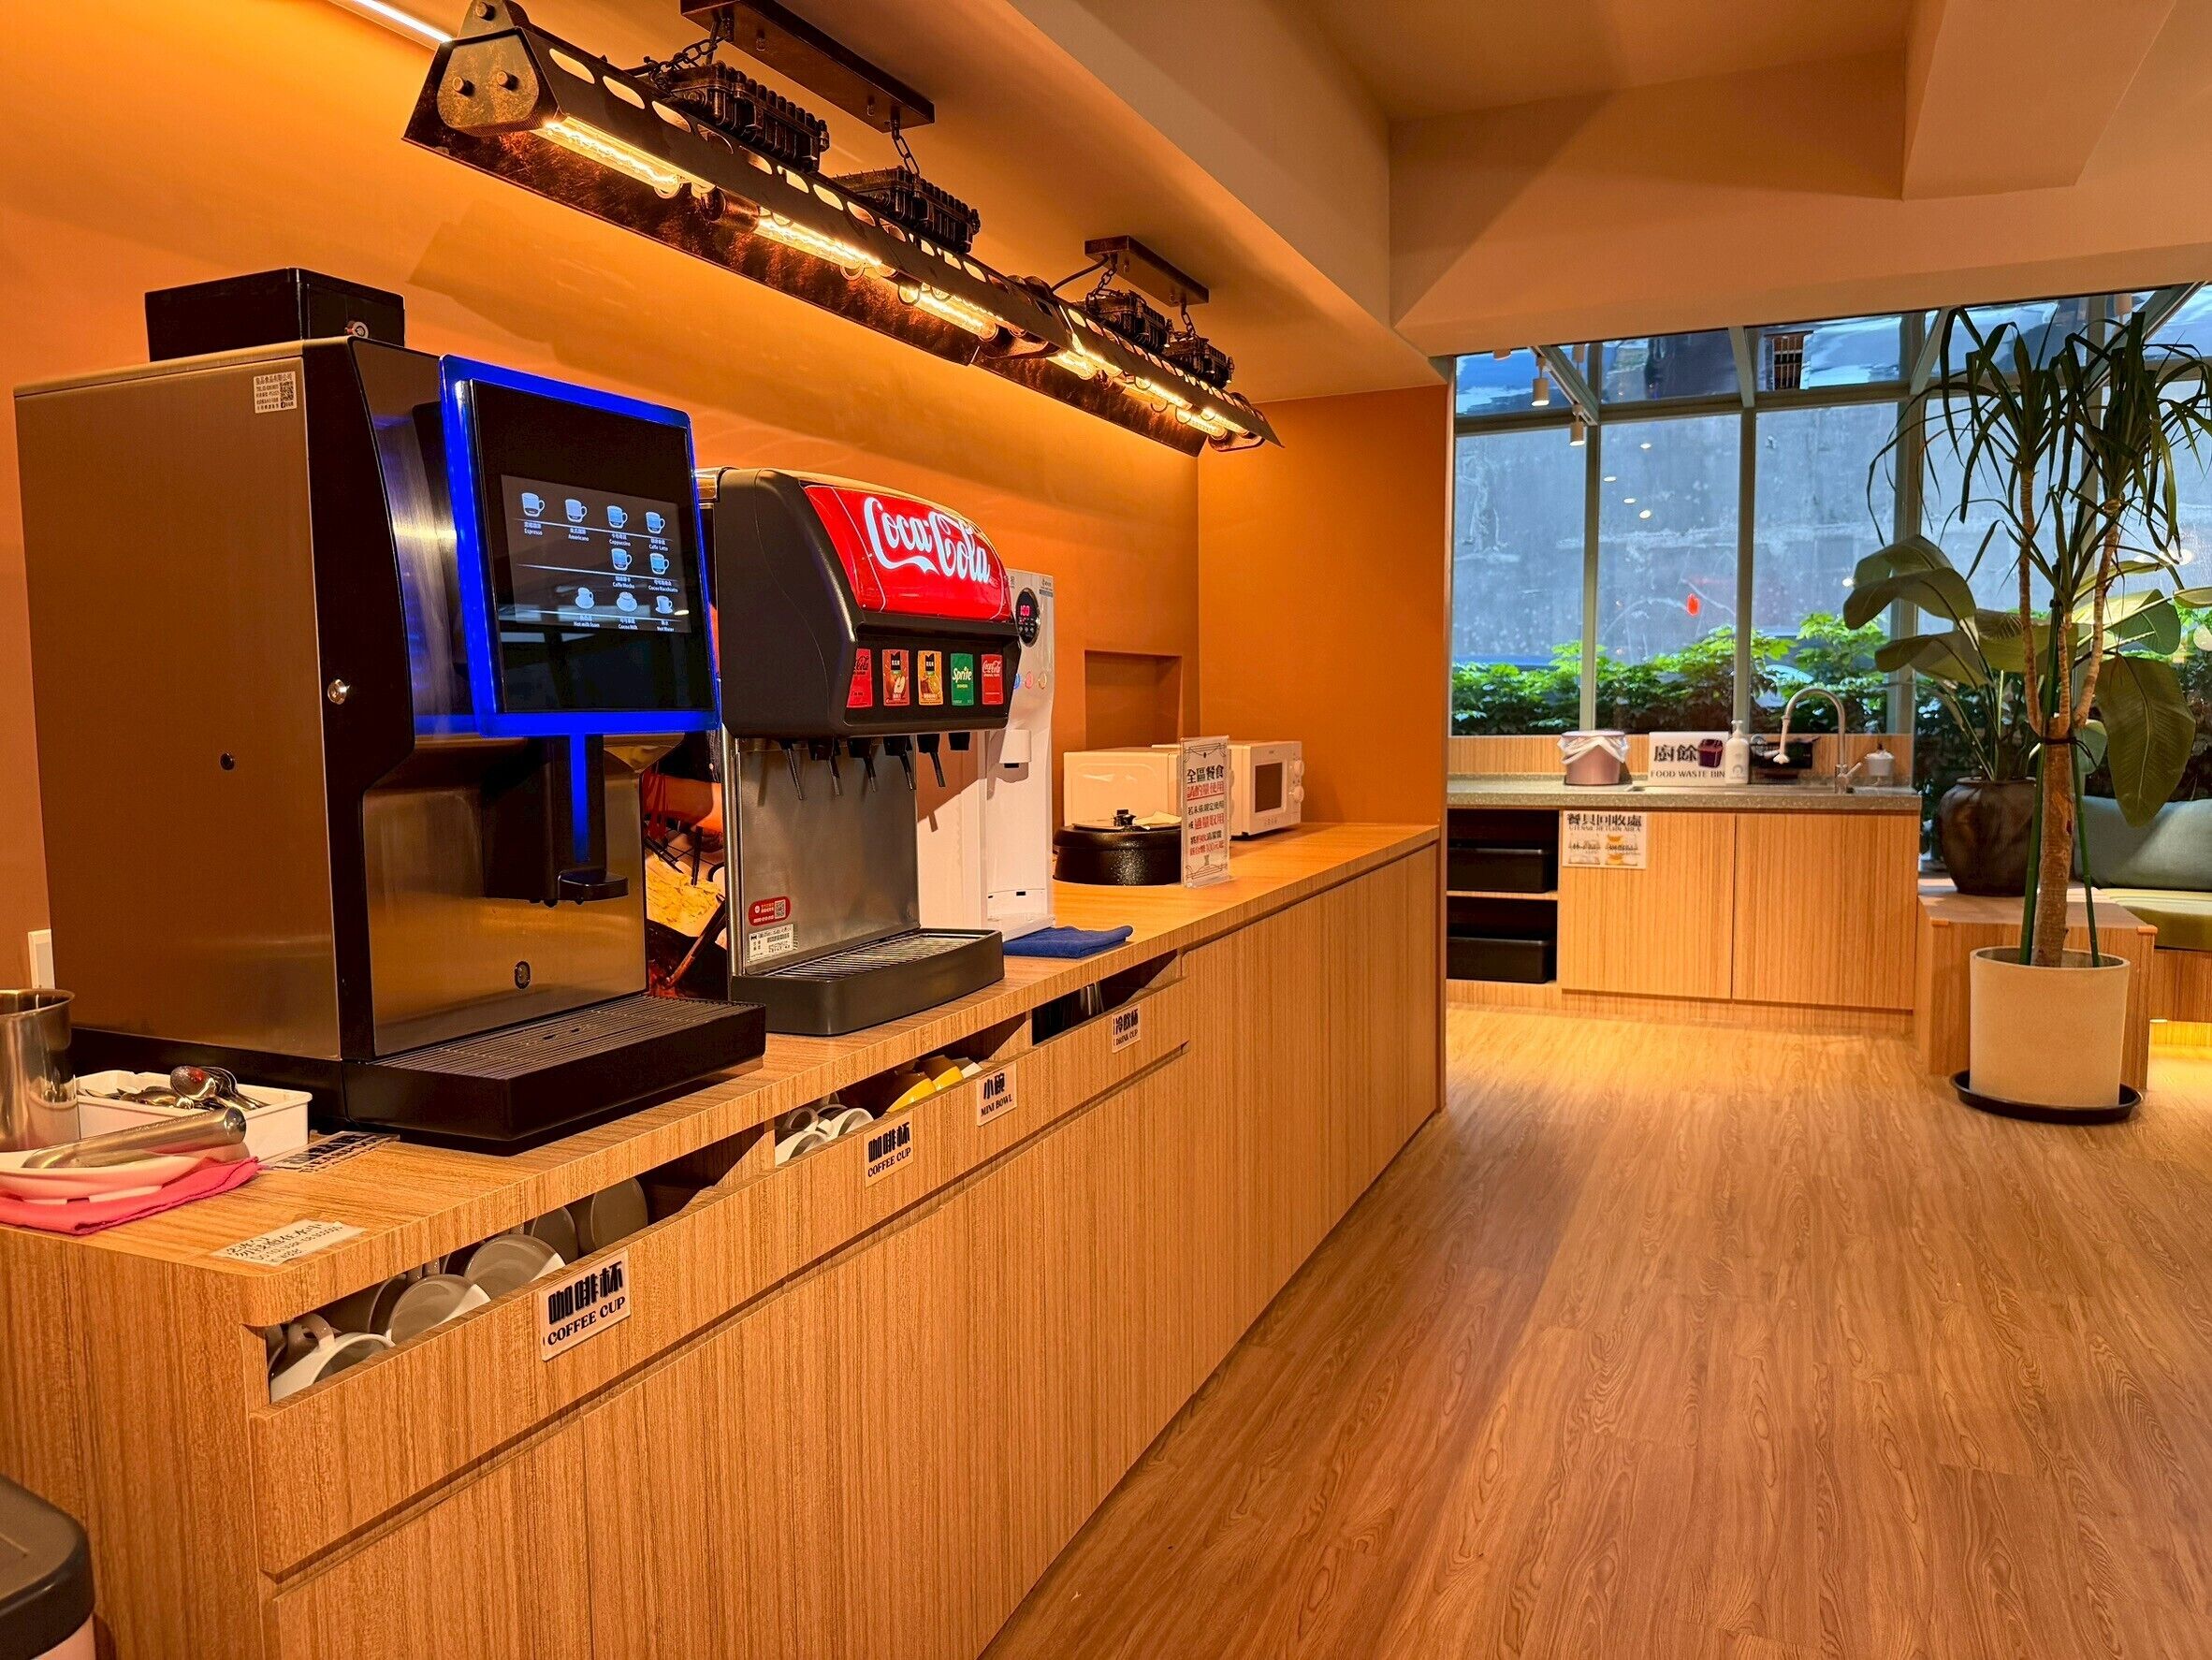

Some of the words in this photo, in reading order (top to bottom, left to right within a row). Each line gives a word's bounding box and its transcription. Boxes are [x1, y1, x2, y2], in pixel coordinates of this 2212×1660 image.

[864, 497, 990, 583] Coca-Cola
[952, 666, 972, 682] Sprite
[1653, 744, 1698, 763] 廚餘
[1186, 764, 1225, 784] 全區餐食
[1651, 770, 1676, 779] FOOD
[1678, 770, 1706, 779] WASTE
[1710, 770, 1725, 779] BIN
[1128, 1028, 1139, 1040] CUP
[982, 1072, 1005, 1099] 小碗
[981, 1101, 995, 1117] MINI
[995, 1094, 1012, 1110] BOWL
[868, 1121, 910, 1163] 咖啡杯
[867, 1155, 895, 1178] COFFEE
[896, 1146, 911, 1161] CUP
[547, 1260, 624, 1325] 咖啡杯
[547, 1310, 597, 1346] COFFEE
[599, 1295, 626, 1318] CUP
